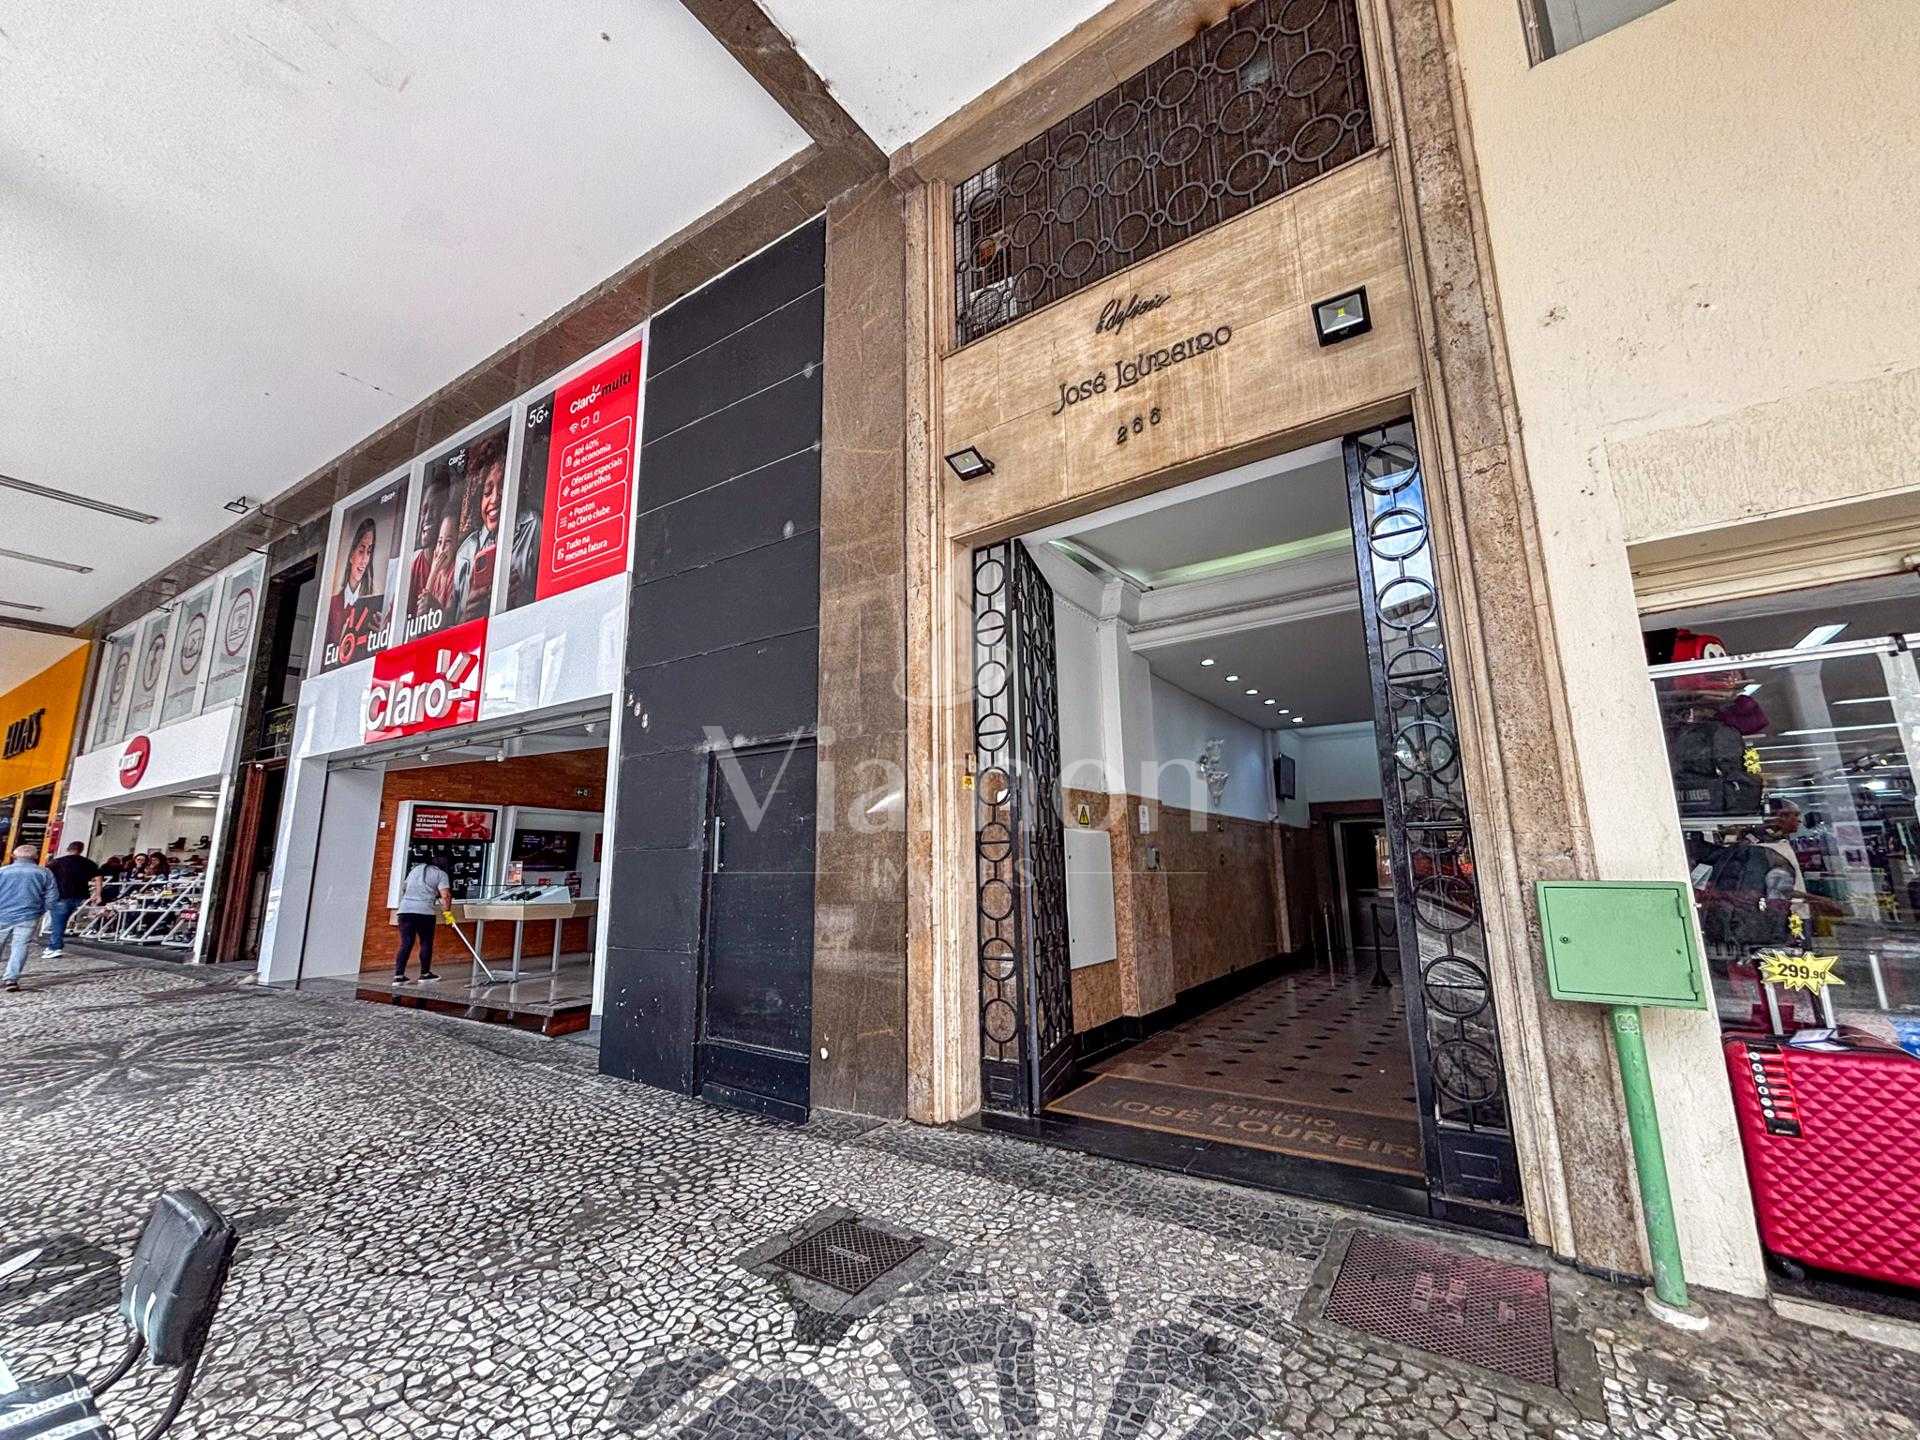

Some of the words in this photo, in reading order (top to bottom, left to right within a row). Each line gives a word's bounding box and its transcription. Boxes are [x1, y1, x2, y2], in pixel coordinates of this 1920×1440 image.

[1114, 325, 1232, 392] LOUREIRO
[601, 371, 632, 397] multi
[1116, 406, 1162, 445] 266
[576, 513, 594, 526] Claro
[566, 538, 582, 551] Tudo
[324, 641, 339, 666] Eu
[404, 608, 443, 644] junto
[366, 670, 452, 732] Claro
